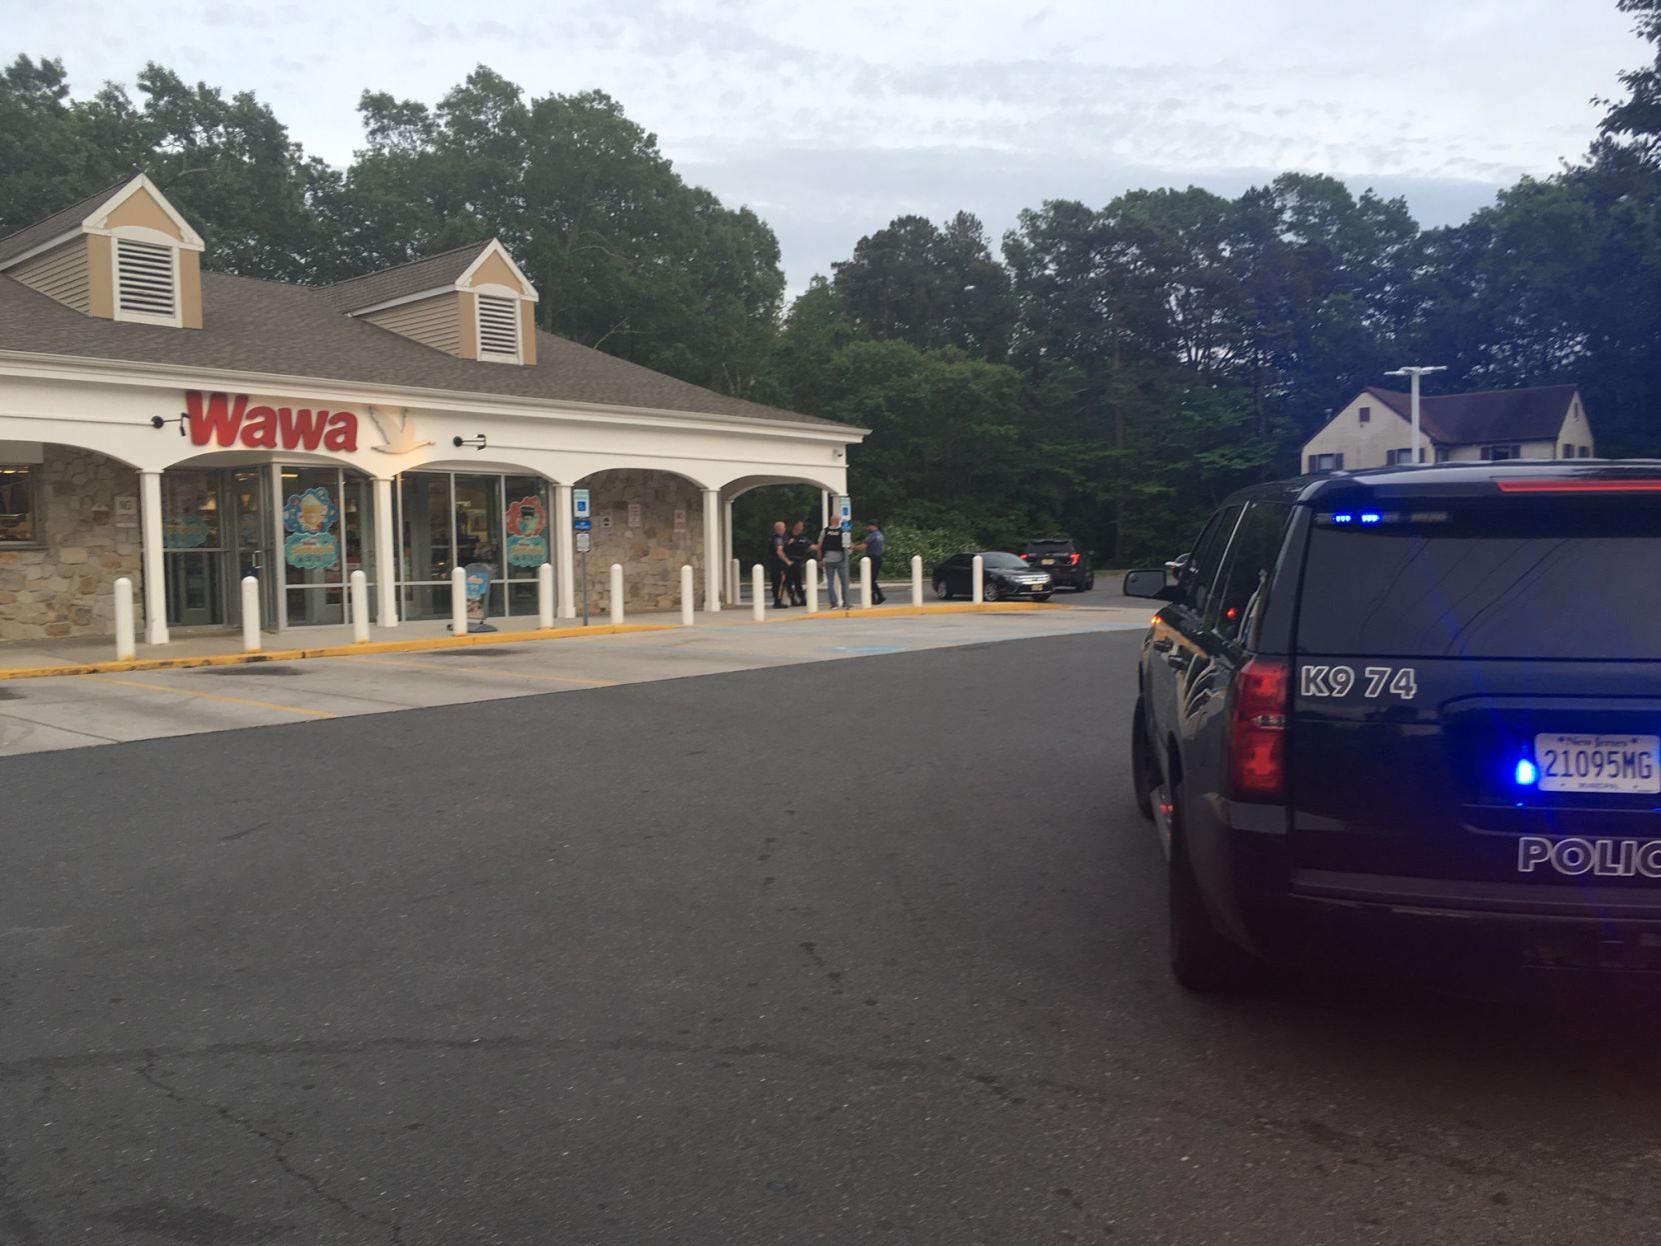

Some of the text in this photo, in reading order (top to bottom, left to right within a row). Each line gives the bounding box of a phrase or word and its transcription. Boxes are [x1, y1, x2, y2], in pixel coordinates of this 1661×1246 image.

[186, 390, 358, 452] Wawa
[1301, 665, 1417, 699] K9 74
[1544, 749, 1652, 779] 21095MG
